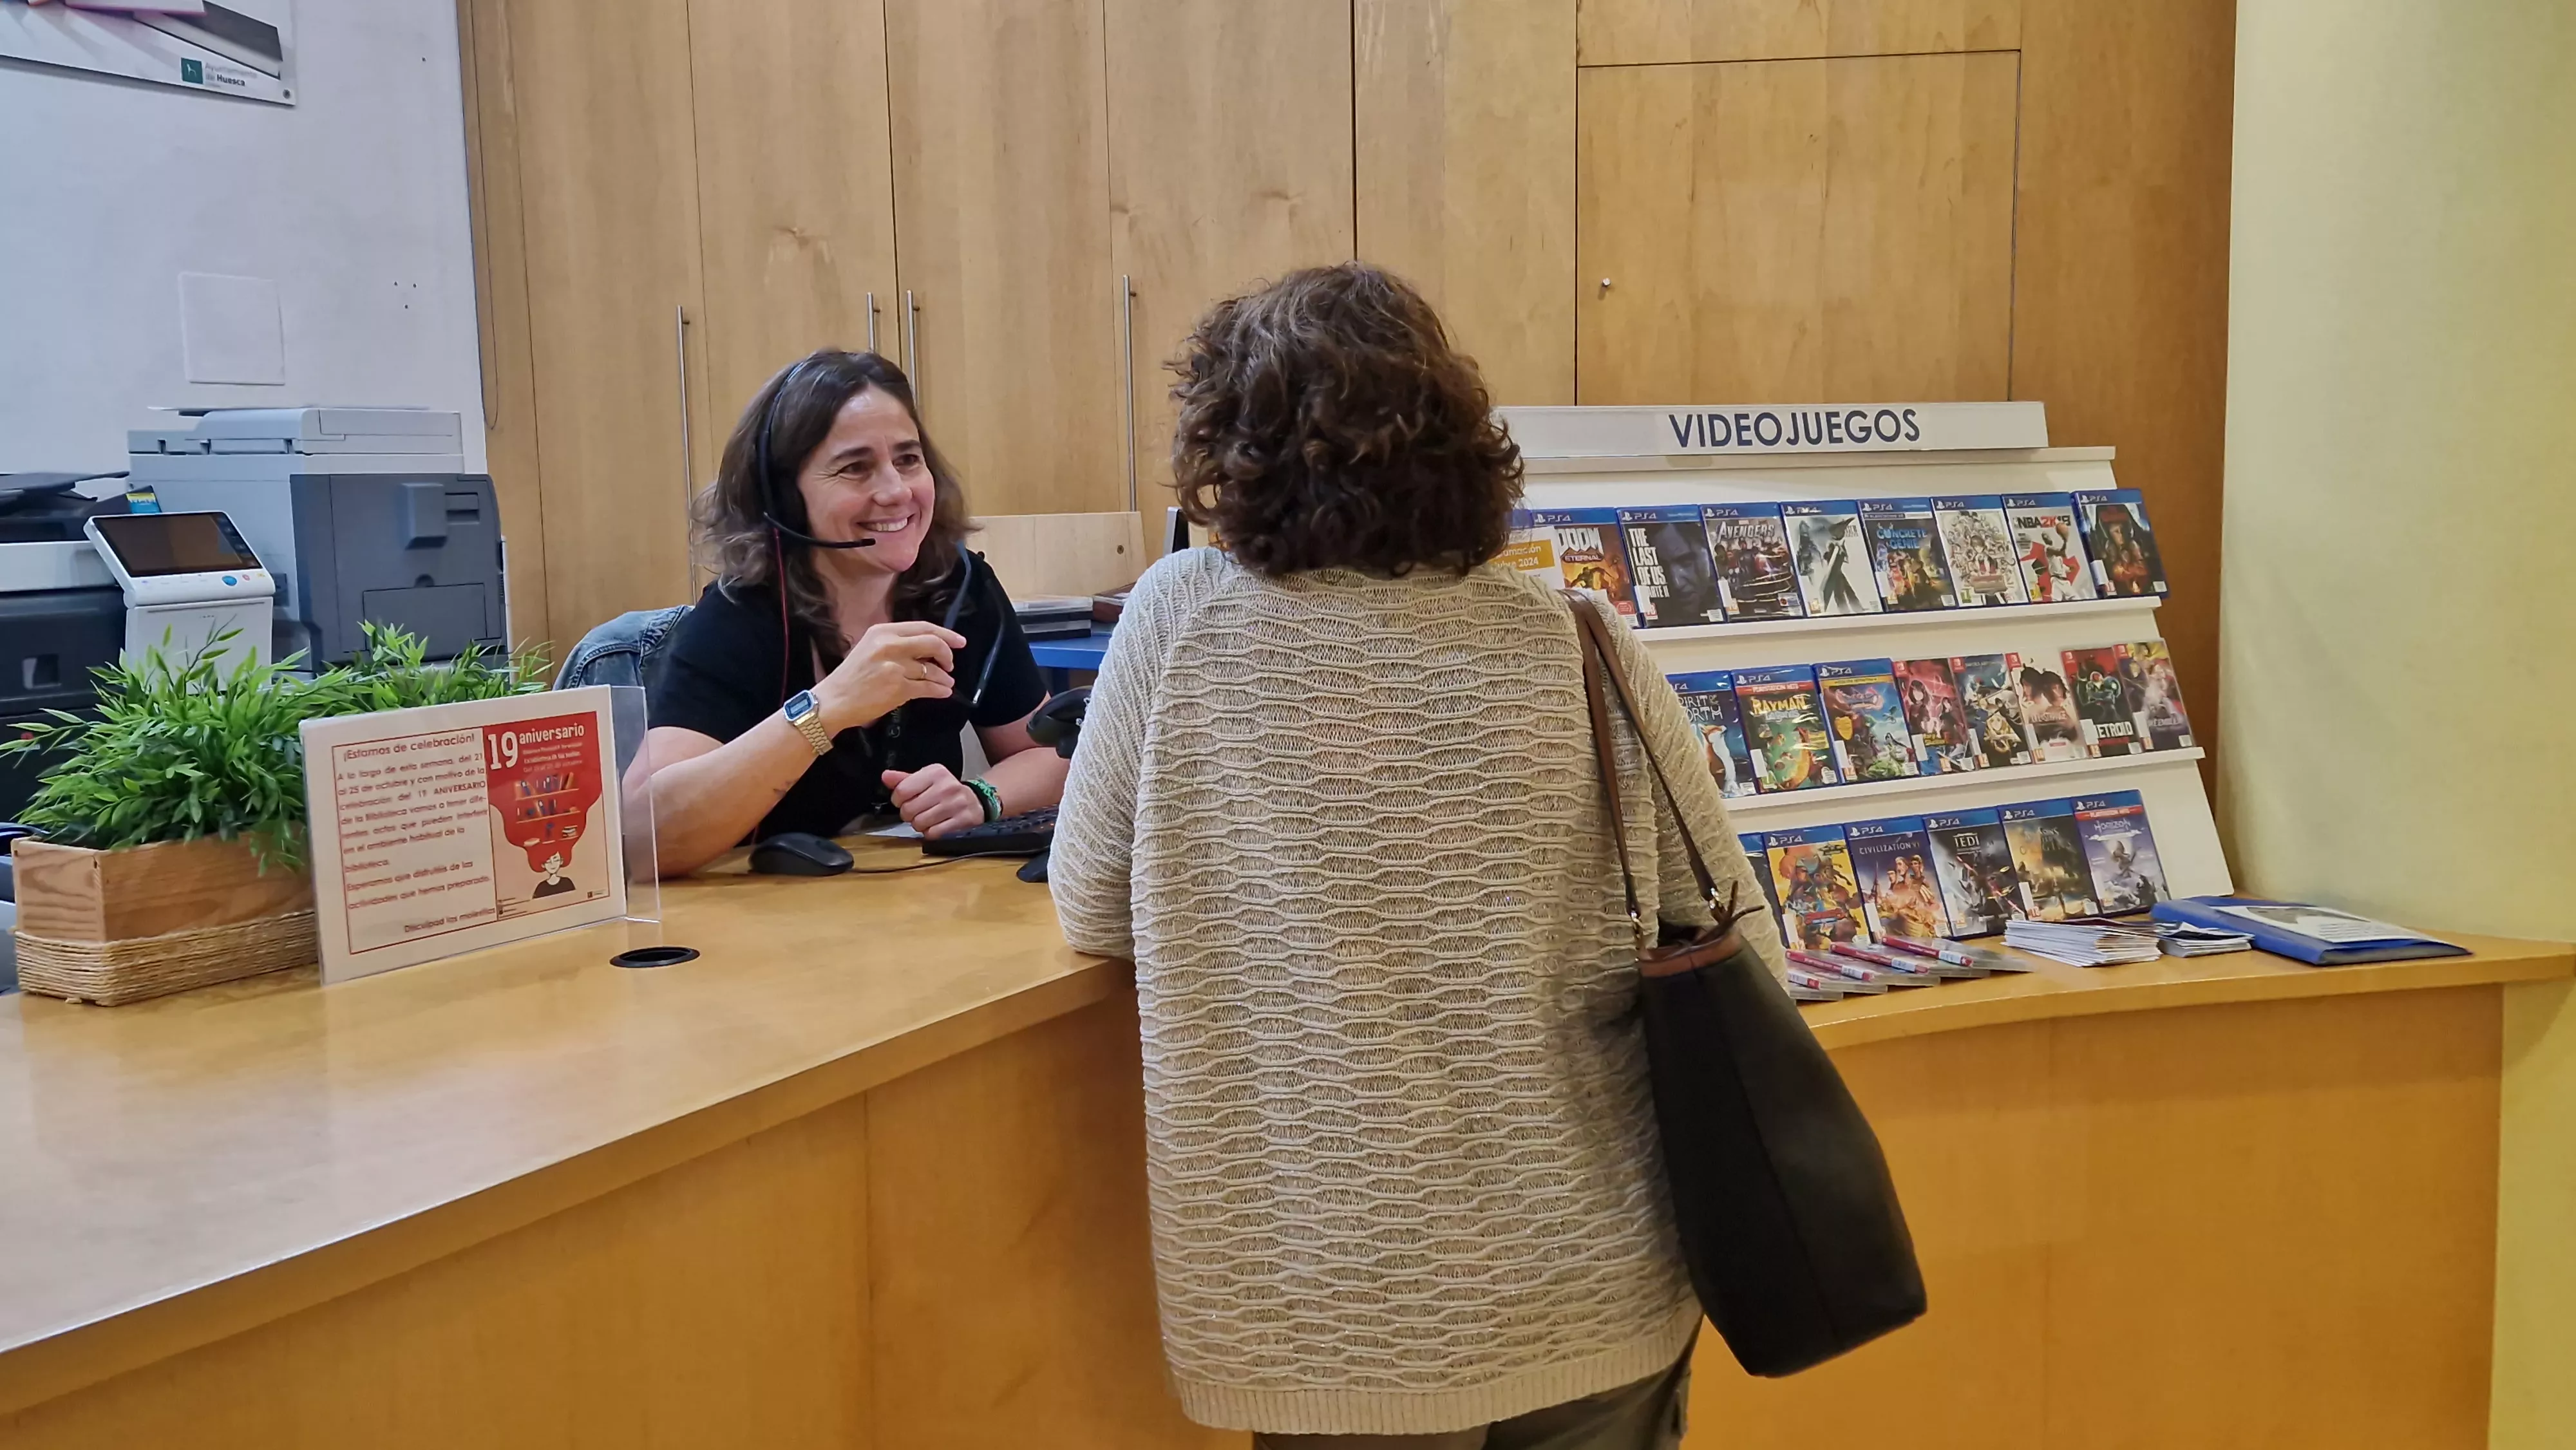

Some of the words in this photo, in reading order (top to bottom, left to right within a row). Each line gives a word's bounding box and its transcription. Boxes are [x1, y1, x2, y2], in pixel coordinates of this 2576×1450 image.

[216, 74, 246, 87] Huesca
[1668, 408, 1920, 447] VIDEOJUEGOS
[1628, 528, 1650, 547] THE
[1717, 521, 1775, 543] AVENGERS
[1877, 528, 1929, 540] CONCRETE
[1557, 527, 1604, 558] DOOM
[1518, 556, 1539, 567] 2024
[1632, 547, 1659, 566] LAST
[1636, 566, 1651, 585] OF
[1651, 565, 1667, 585] US
[1831, 666, 1852, 675] PS4
[1748, 674, 1771, 683] PS4
[1677, 695, 1708, 708] PIRIT
[1751, 695, 1808, 715] RAYMAN
[1685, 706, 1723, 722] ORTH
[2096, 721, 2134, 739] ETROID
[343, 747, 391, 762] ¡Estamos
[393, 744, 407, 753] de
[410, 733, 475, 751] celebración!
[488, 731, 518, 770] 19
[518, 722, 585, 745] aniversario
[433, 780, 486, 795] ANIVERSARIO
[2086, 800, 2106, 808] PS4
[2014, 809, 2036, 818] PS4
[1939, 818, 1960, 827] PS4
[1860, 825, 1884, 835] PS4
[1779, 834, 1803, 844] PS4
[1859, 842, 1911, 855] CIVILIZATION
